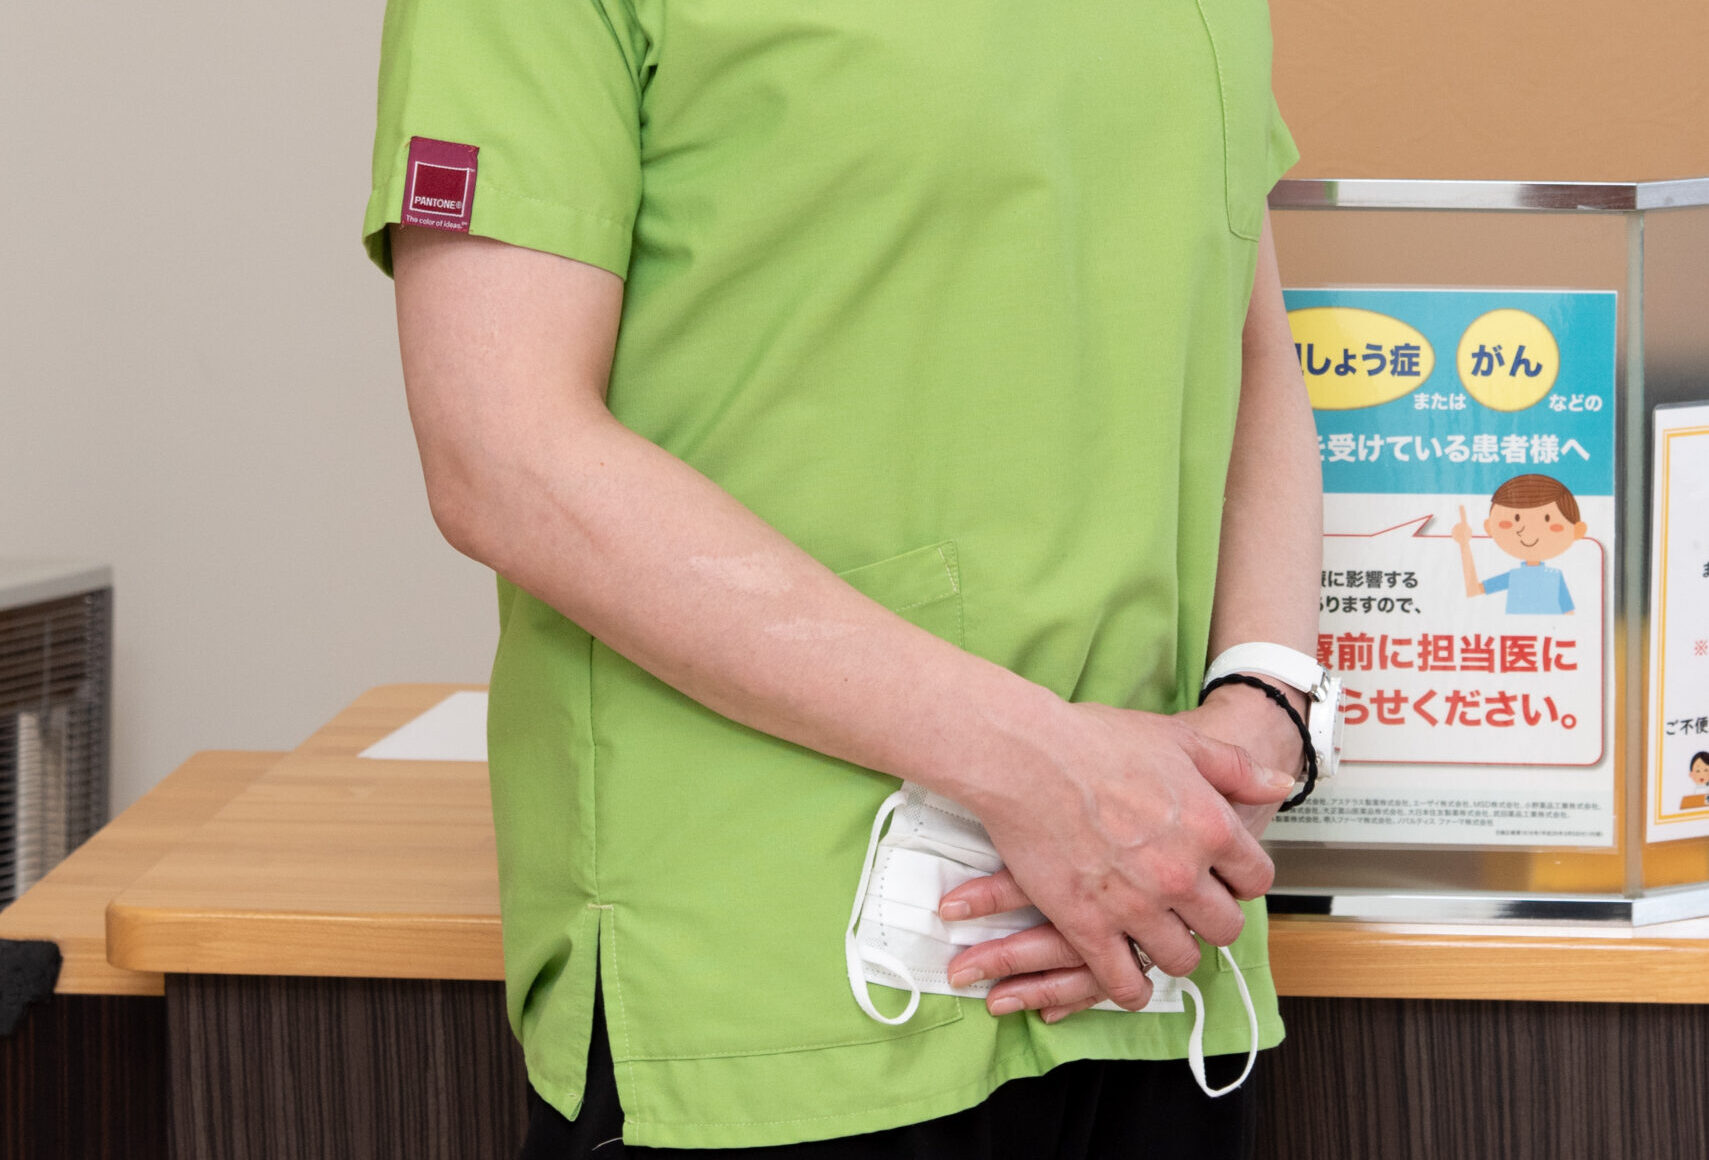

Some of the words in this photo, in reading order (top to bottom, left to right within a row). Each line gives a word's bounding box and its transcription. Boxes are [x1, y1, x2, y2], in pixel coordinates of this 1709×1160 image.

[406, 215, 418, 223] The
[419, 218, 435, 226] color
[1295, 343, 1421, 377] しょう症
[1471, 344, 1543, 378] がん
[1413, 393, 1467, 411] または
[1549, 394, 1603, 412] などの
[1319, 595, 1422, 614] りますので、
[1338, 687, 1578, 730] らせください。
